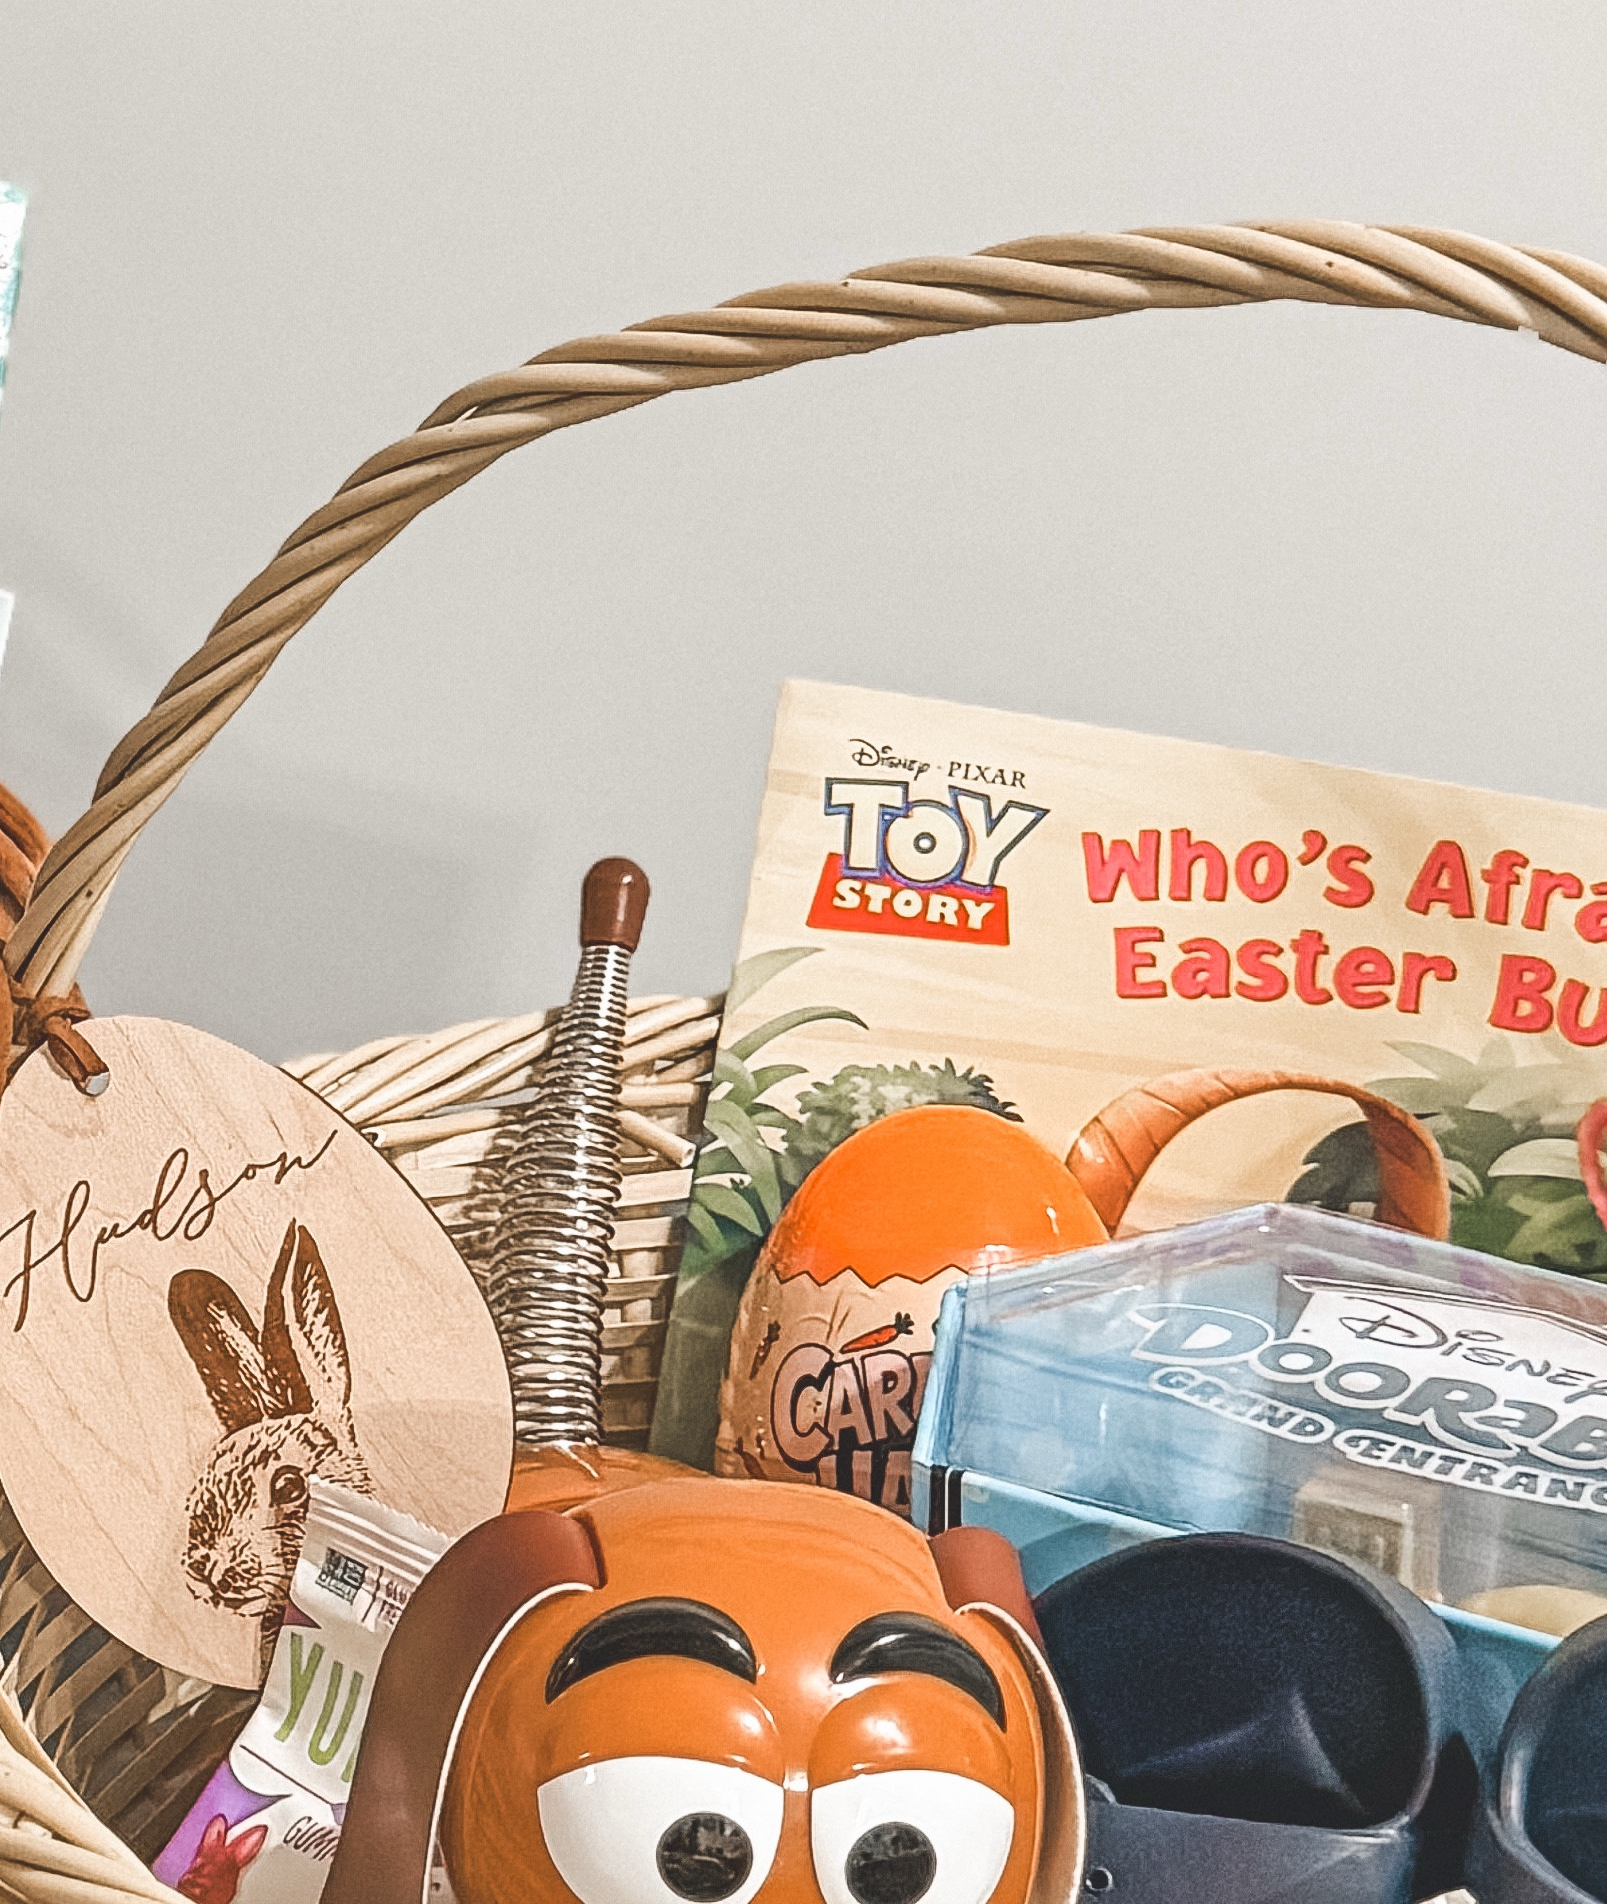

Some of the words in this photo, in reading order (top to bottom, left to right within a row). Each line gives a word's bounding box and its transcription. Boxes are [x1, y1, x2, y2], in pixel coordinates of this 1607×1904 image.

[947, 760, 1027, 789] PIXAR
[824, 777, 1051, 896] TOY
[832, 878, 995, 930] STORY
[1113, 927, 1457, 1014] Easter
[1487, 953, 1607, 1047] Bu
[1152, 1367, 1333, 1441] GRAND
[273, 1632, 365, 1784] YU
